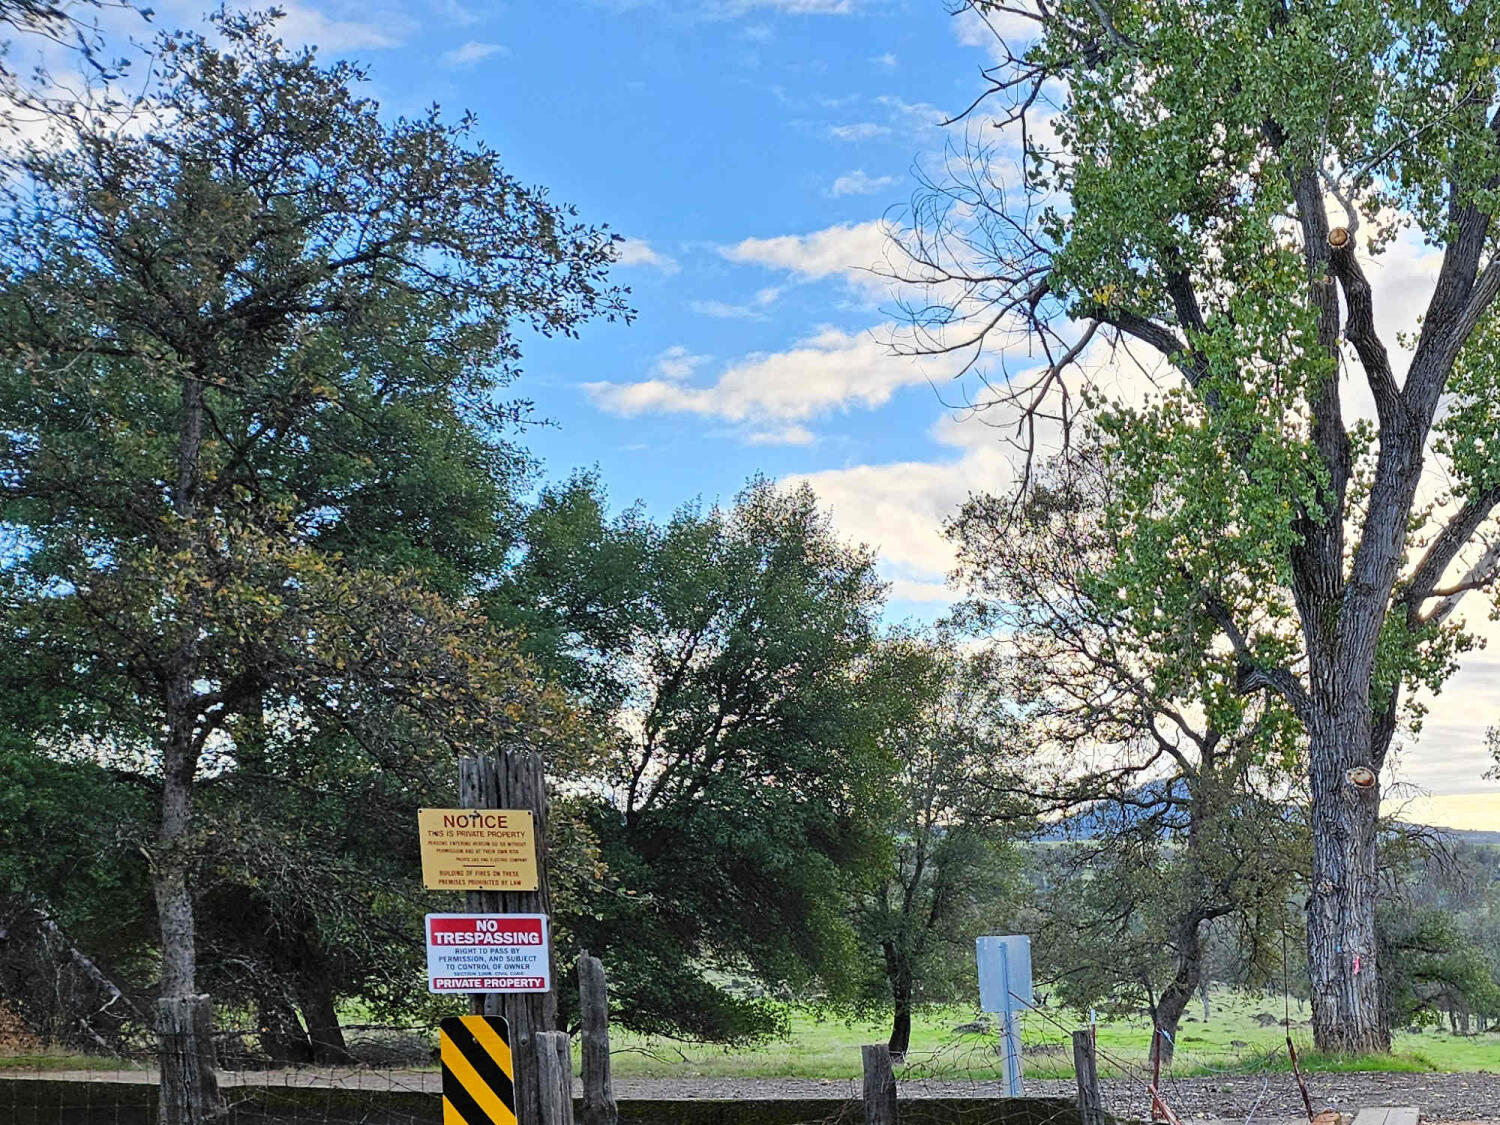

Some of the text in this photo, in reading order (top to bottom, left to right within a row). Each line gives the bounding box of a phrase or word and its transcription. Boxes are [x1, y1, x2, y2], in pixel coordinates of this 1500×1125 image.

[444, 815, 508, 828] NOTICE
[476, 920, 498, 932] NO
[434, 933, 540, 944] TRESPASSING
[436, 979, 541, 988] PRIVATE PROPERTY
